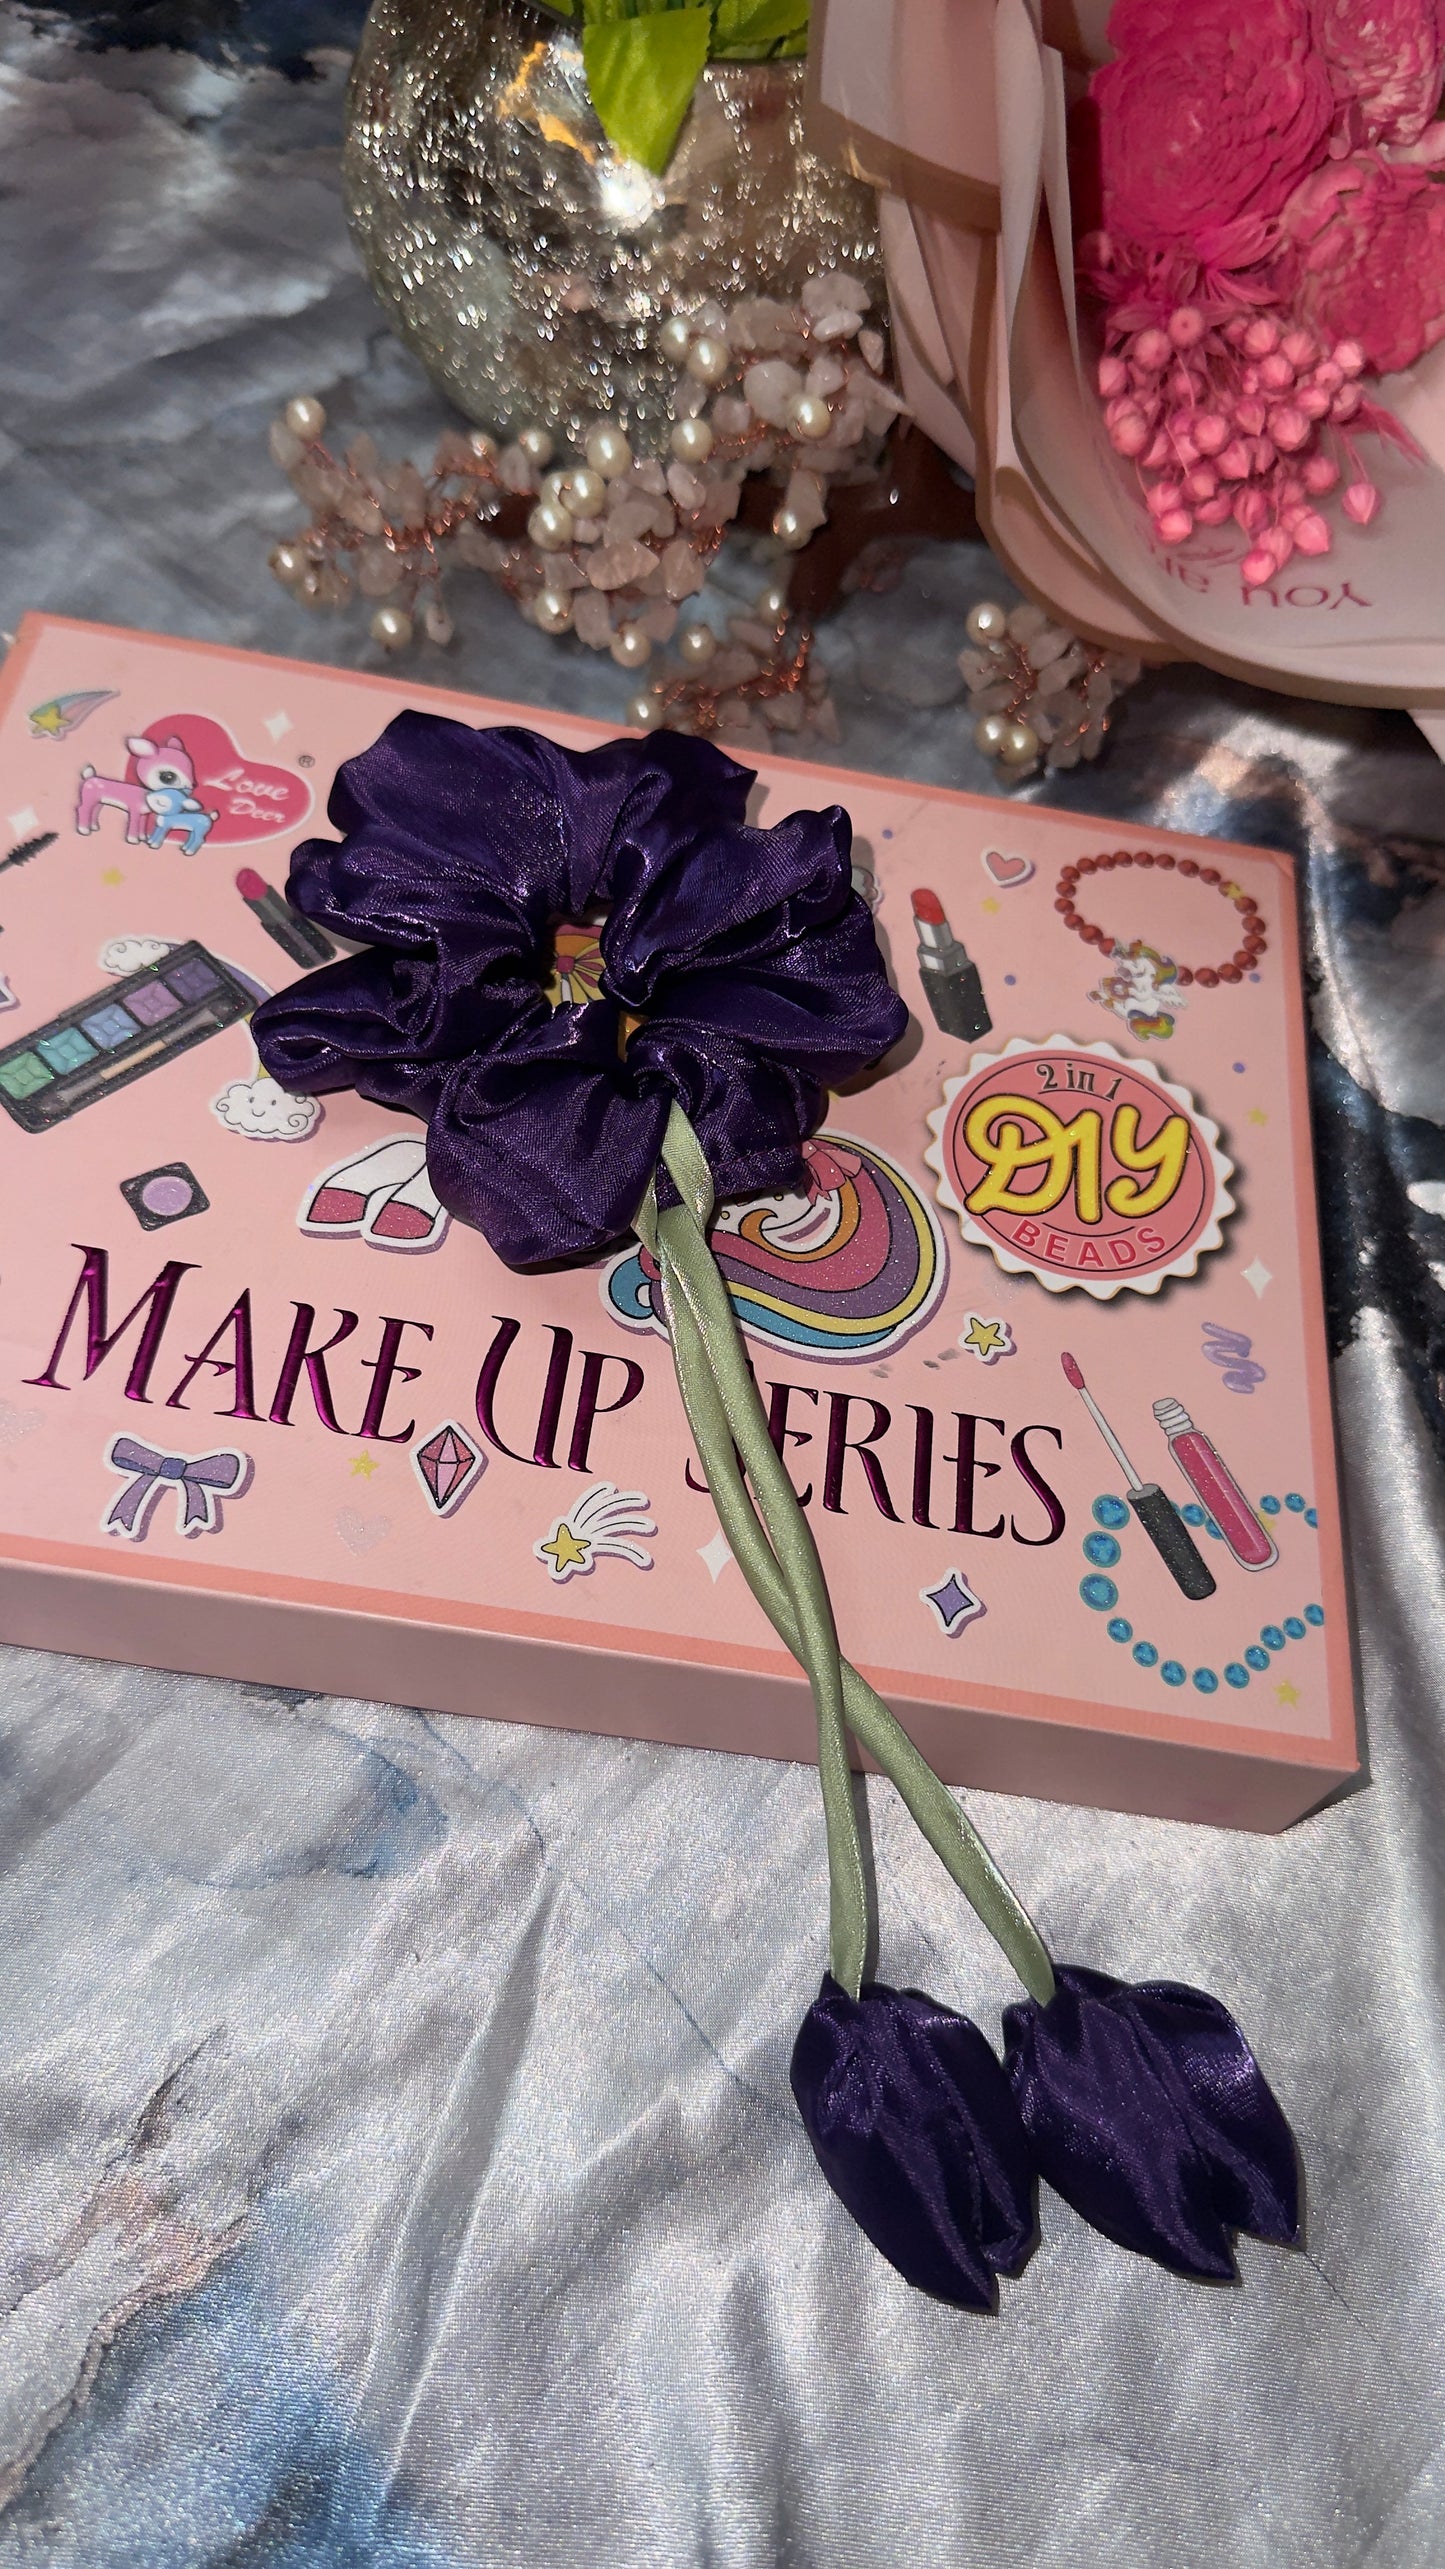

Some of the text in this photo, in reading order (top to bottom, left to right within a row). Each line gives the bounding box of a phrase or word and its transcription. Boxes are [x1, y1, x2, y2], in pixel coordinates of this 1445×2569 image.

[203, 767, 289, 801] Love
[229, 798, 286, 824] Deer
[1036, 1062, 1122, 1100] 2 in 1
[963, 1093, 1191, 1225] DIY
[1012, 1219, 1166, 1268] BEADS
[20, 1243, 435, 1444] MAKE
[475, 1315, 646, 1474] UP
